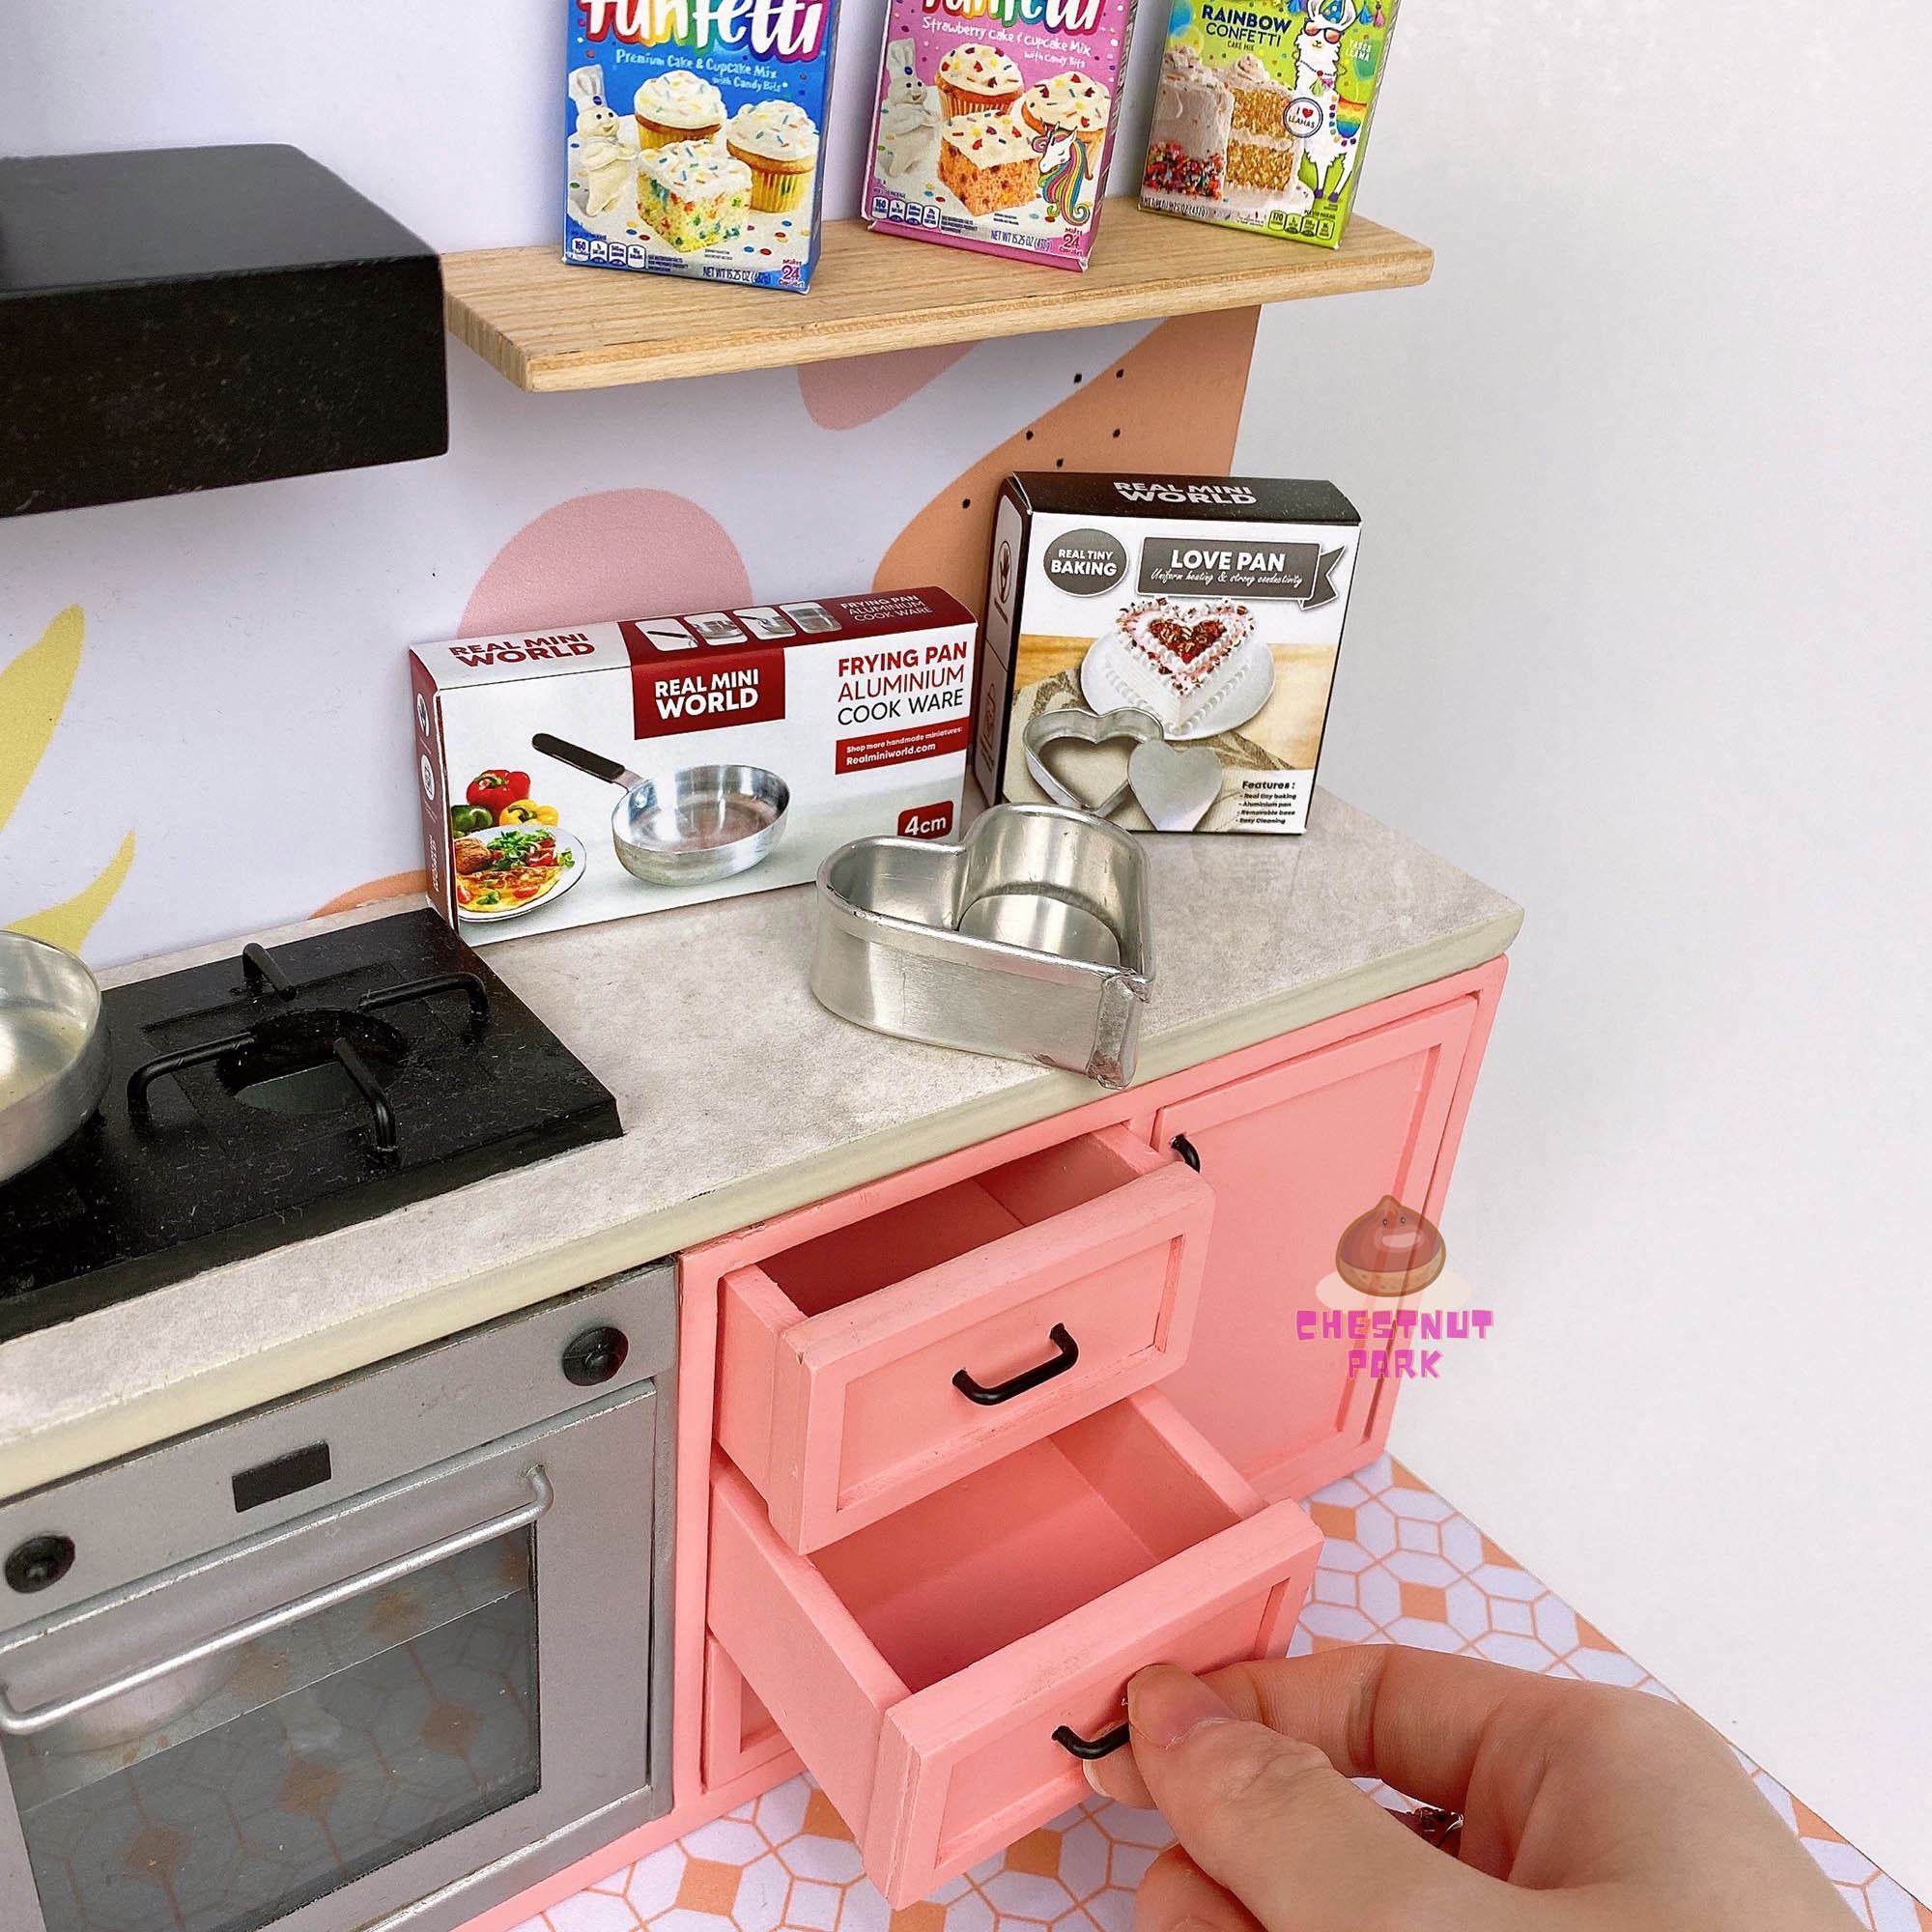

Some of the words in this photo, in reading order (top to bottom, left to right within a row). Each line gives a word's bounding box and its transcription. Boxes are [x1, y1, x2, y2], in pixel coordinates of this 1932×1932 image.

[1202, 4, 1293, 34] RAINBOW
[923, 16, 986, 41] Strawberry
[1069, 40, 1092, 57] Mix
[1206, 22, 1281, 47] CONFETTI
[1227, 41, 1242, 50] CAKE
[1243, 43, 1255, 51] MIX
[615, 48, 665, 66] Premium
[667, 55, 694, 70] Cake
[696, 58, 704, 70] &
[706, 58, 752, 78] Cupcake
[753, 65, 778, 79] Mix
[733, 76, 762, 93] Candy
[1288, 115, 1315, 128] LLAMAS
[990, 230, 1001, 241] NET
[1063, 233, 1080, 248] 24
[703, 266, 715, 277] NET
[716, 267, 726, 278] WT
[742, 270, 751, 282] OZ
[781, 265, 801, 280] 24
[1113, 481, 1184, 493] REAL
[1188, 485, 1253, 495] MINI
[1118, 491, 1258, 504] WORLD
[1058, 549, 1087, 559] REAL
[1088, 550, 1114, 560] TINY
[1171, 549, 1236, 571] LOVE
[1236, 552, 1286, 573] PAN
[1050, 559, 1119, 577] BAKING
[1217, 571, 1229, 583] &
[839, 598, 890, 610] FRYING
[891, 594, 920, 603] PAN
[849, 600, 925, 615] ALUMINIUM
[854, 611, 895, 621] COOK
[895, 607, 934, 617] WARE
[448, 639, 521, 656] REAL
[523, 633, 588, 648] MINI
[456, 641, 596, 668] WORLD
[838, 648, 919, 677] FRYING
[925, 641, 968, 665] PAN
[655, 677, 707, 697] REAL
[711, 668, 759, 690] MINI
[838, 666, 964, 702] ALUMINIUM
[655, 687, 758, 720] WORLD
[838, 698, 901, 725] COOK
[908, 688, 964, 714] WARE
[845, 745, 866, 753] Shop
[866, 741, 886, 751] more
[886, 735, 924, 747] handmade
[845, 743, 936, 766] Realminiworld.com
[904, 815, 947, 836] 4cm
